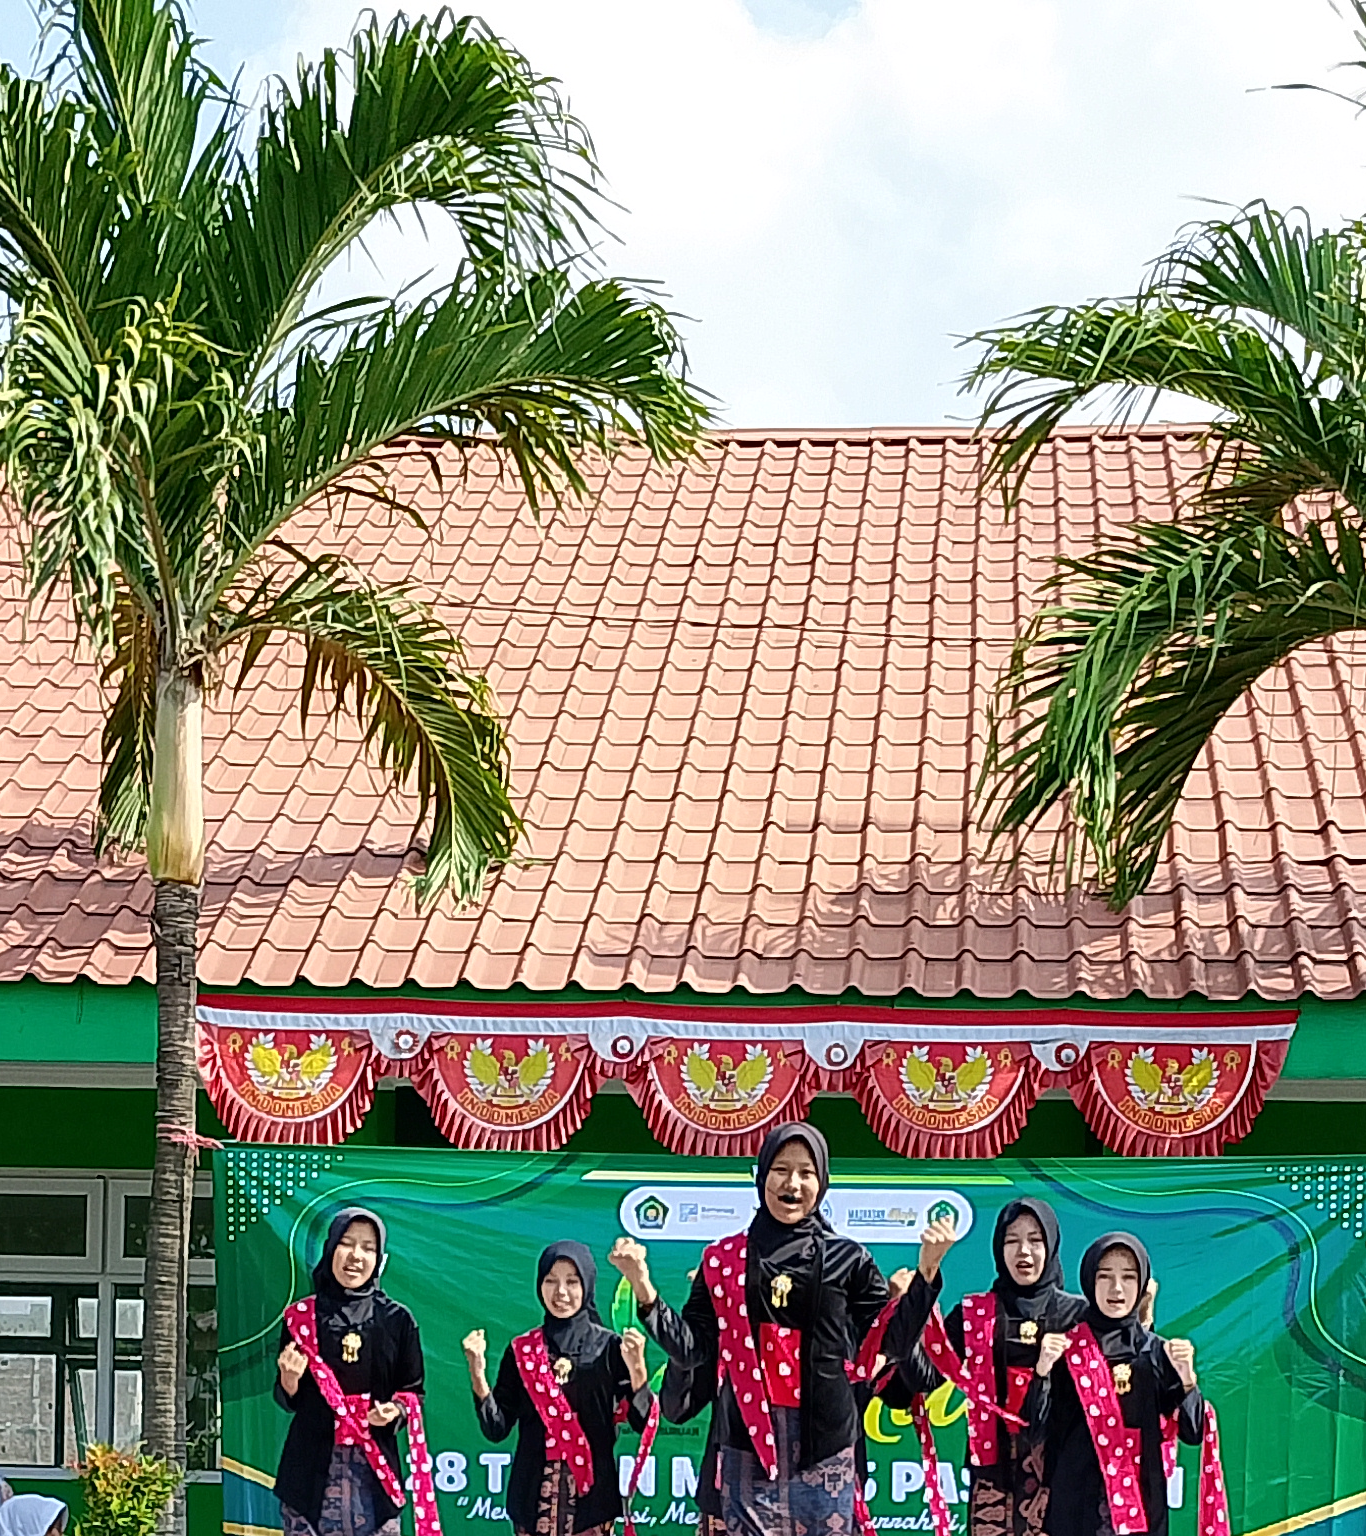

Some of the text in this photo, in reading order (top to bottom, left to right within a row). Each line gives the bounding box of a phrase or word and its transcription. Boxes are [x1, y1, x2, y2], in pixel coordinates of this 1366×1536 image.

[239, 1081, 344, 1117] INDONESIA
[457, 1088, 561, 1125] INDONESIA
[674, 1093, 780, 1130] INDONESIA
[892, 1093, 1000, 1130] INDONESIA
[1117, 1095, 1225, 1134] INDONESIA
